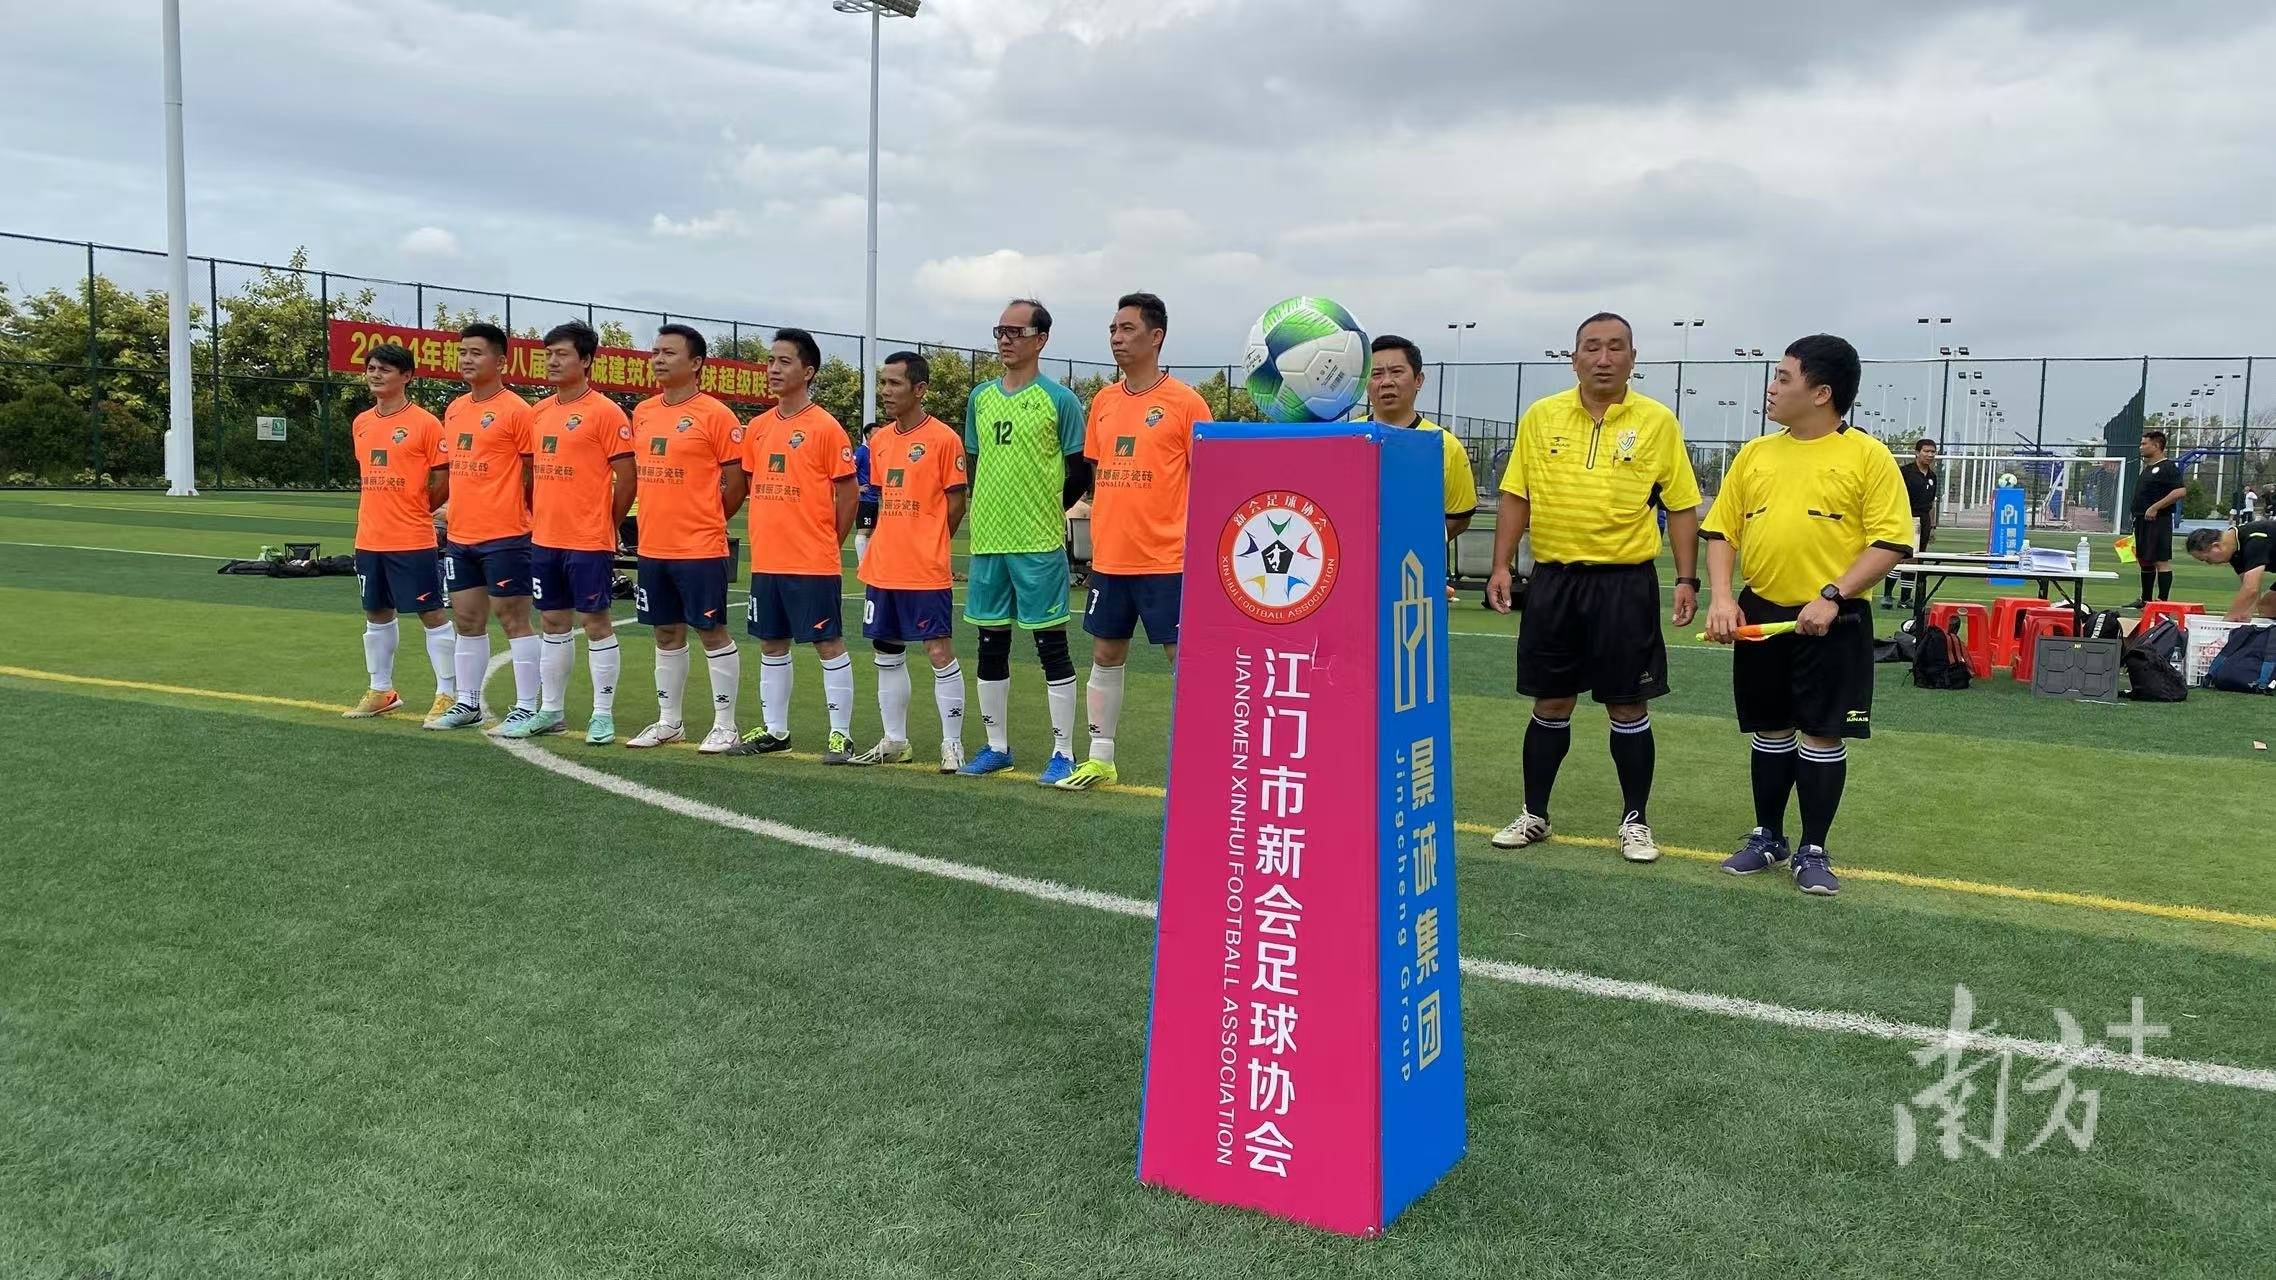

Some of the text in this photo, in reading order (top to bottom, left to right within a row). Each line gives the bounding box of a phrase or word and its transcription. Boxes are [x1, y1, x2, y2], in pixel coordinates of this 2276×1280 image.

[993, 420, 1012, 446] 12
[1222, 555, 1335, 619] XIN HUI FOOTBALL ASSOCIATION
[1216, 647, 1252, 1165] JIANGMEN XINHUI FOOTBALL ASSOCIATION
[1244, 648, 1311, 1178] 江门市新会足球协会
[1395, 748, 1411, 1083] Jingcheng Group
[1411, 736, 1442, 1072] 景诚集团
